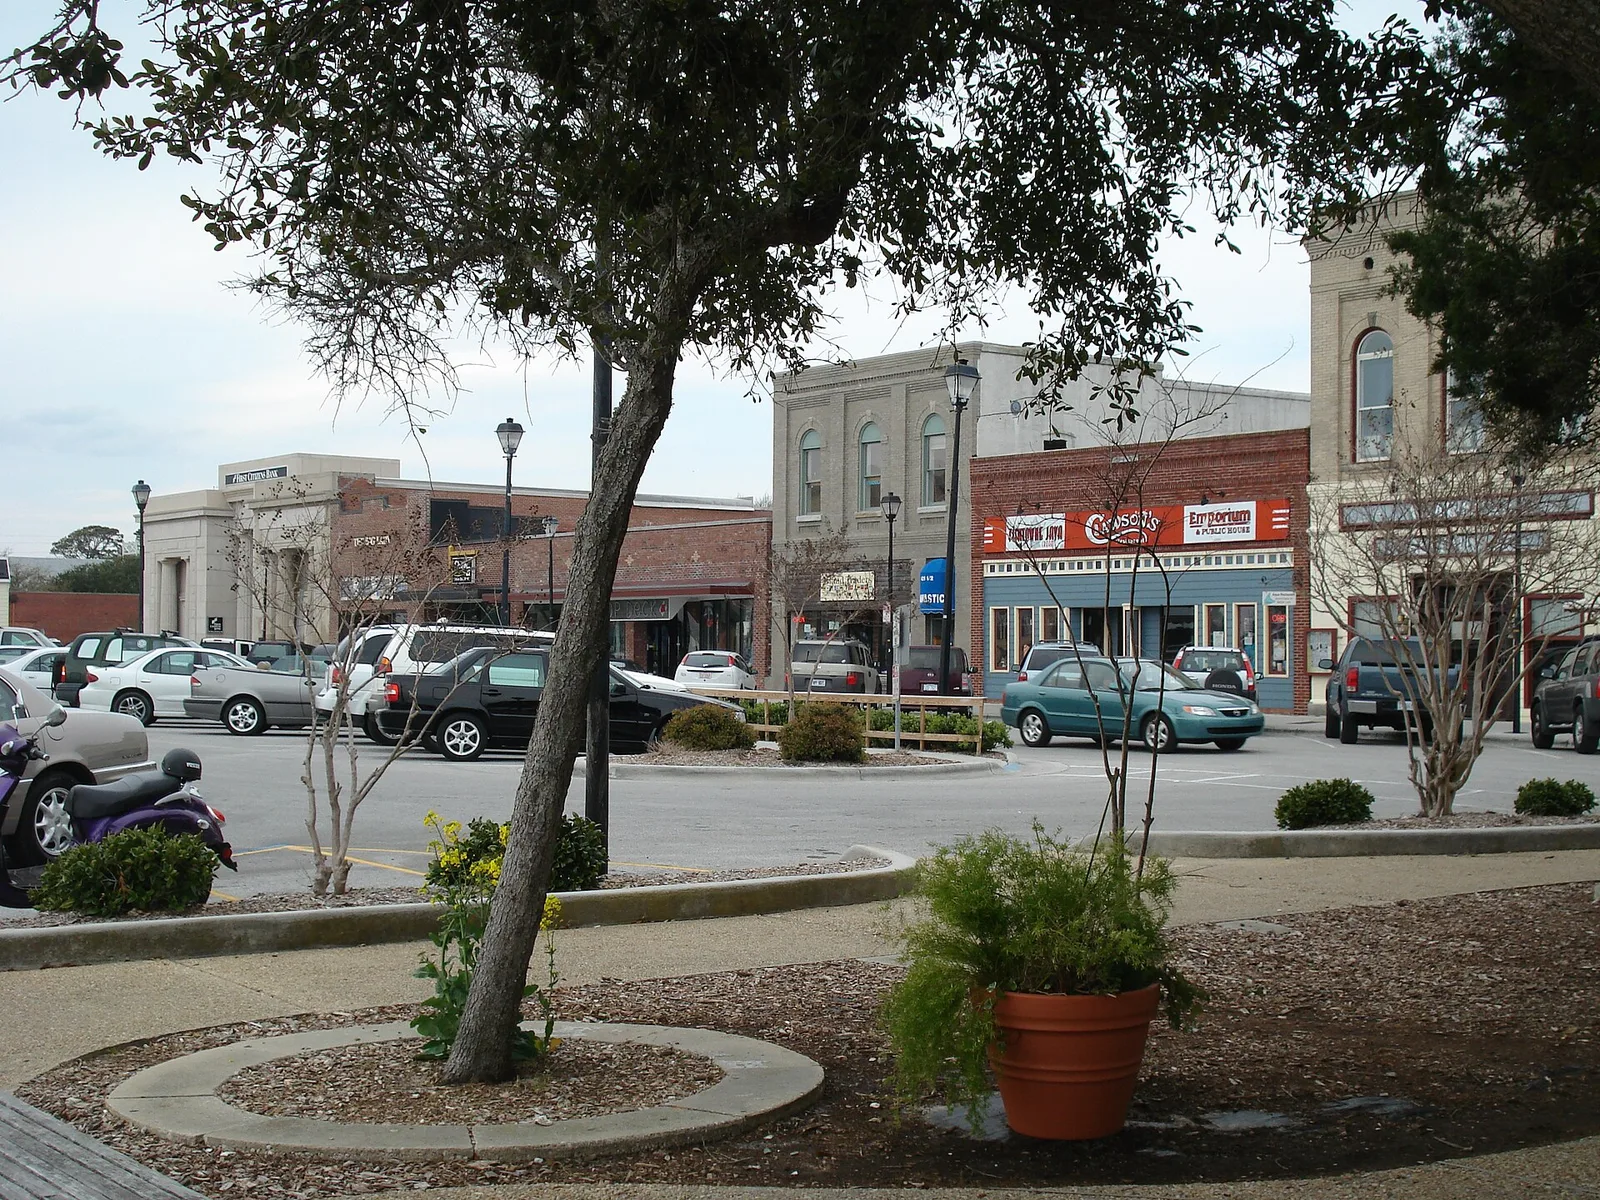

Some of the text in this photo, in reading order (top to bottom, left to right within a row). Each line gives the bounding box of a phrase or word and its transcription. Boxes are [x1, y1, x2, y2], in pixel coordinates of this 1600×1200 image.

[1189, 508, 1251, 527] Emporium
[1201, 527, 1226, 535] PUBLIC
[1227, 526, 1251, 534] HOUSE
